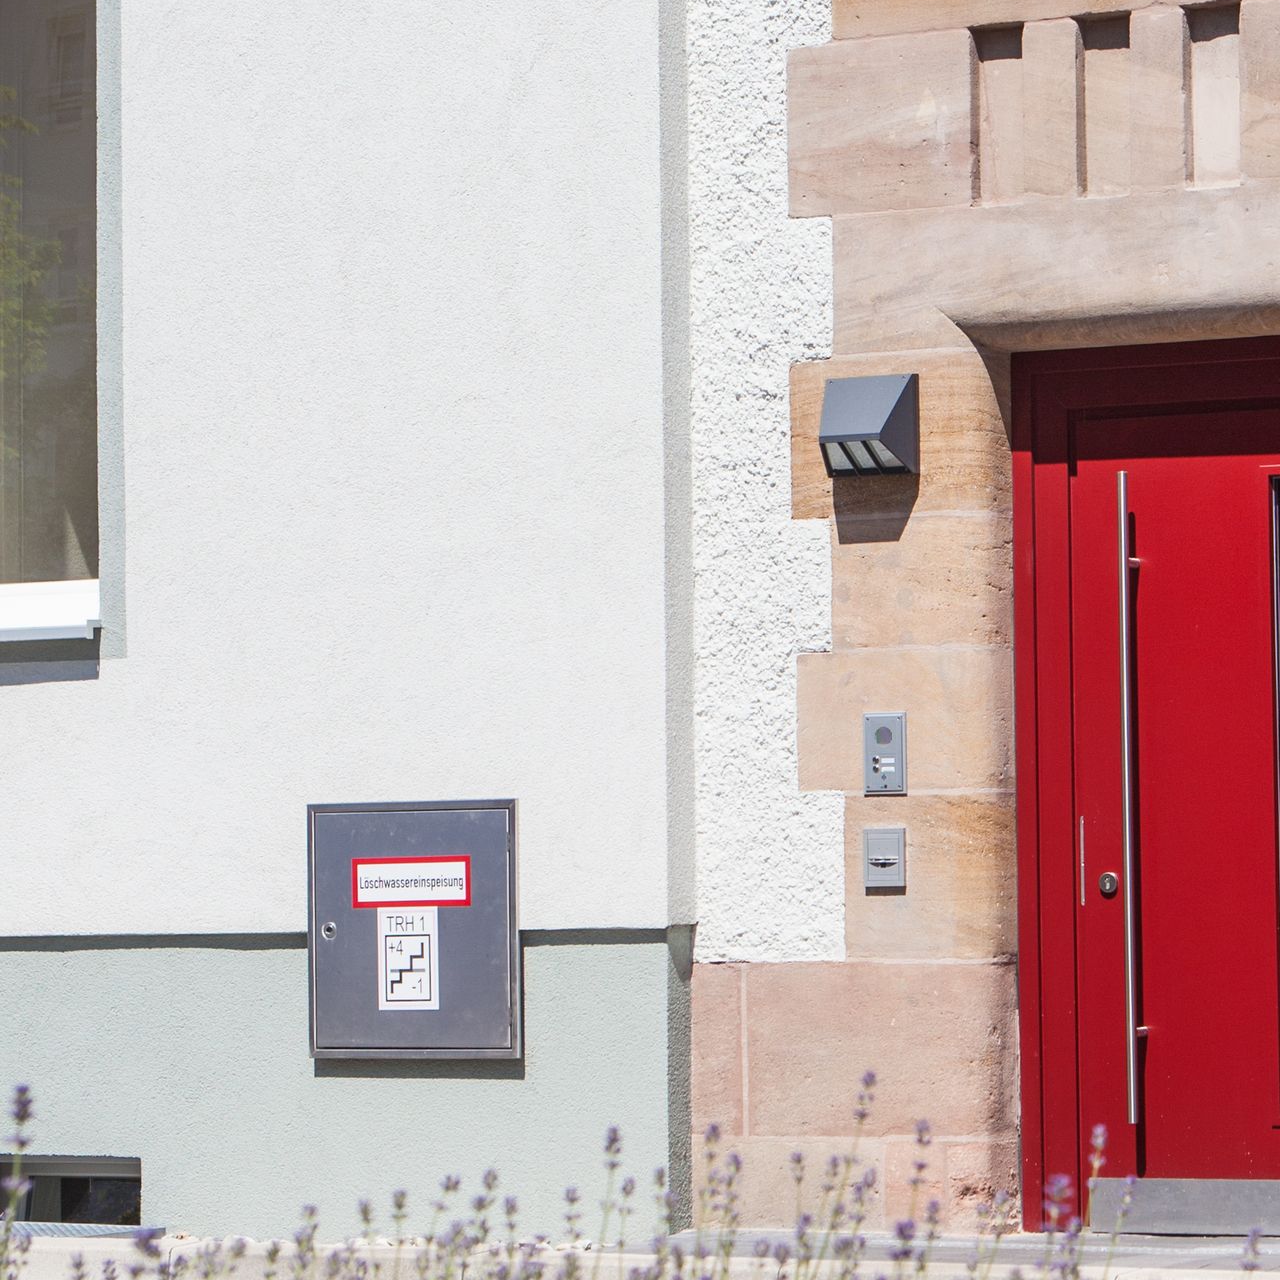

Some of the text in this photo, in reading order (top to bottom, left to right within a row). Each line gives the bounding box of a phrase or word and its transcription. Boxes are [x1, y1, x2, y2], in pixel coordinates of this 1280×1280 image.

[360, 875, 464, 890] Löschwassereinspeisung
[386, 915, 426, 932] TRH 1
[388, 940, 404, 955] +4
[412, 978, 424, 994] -1
